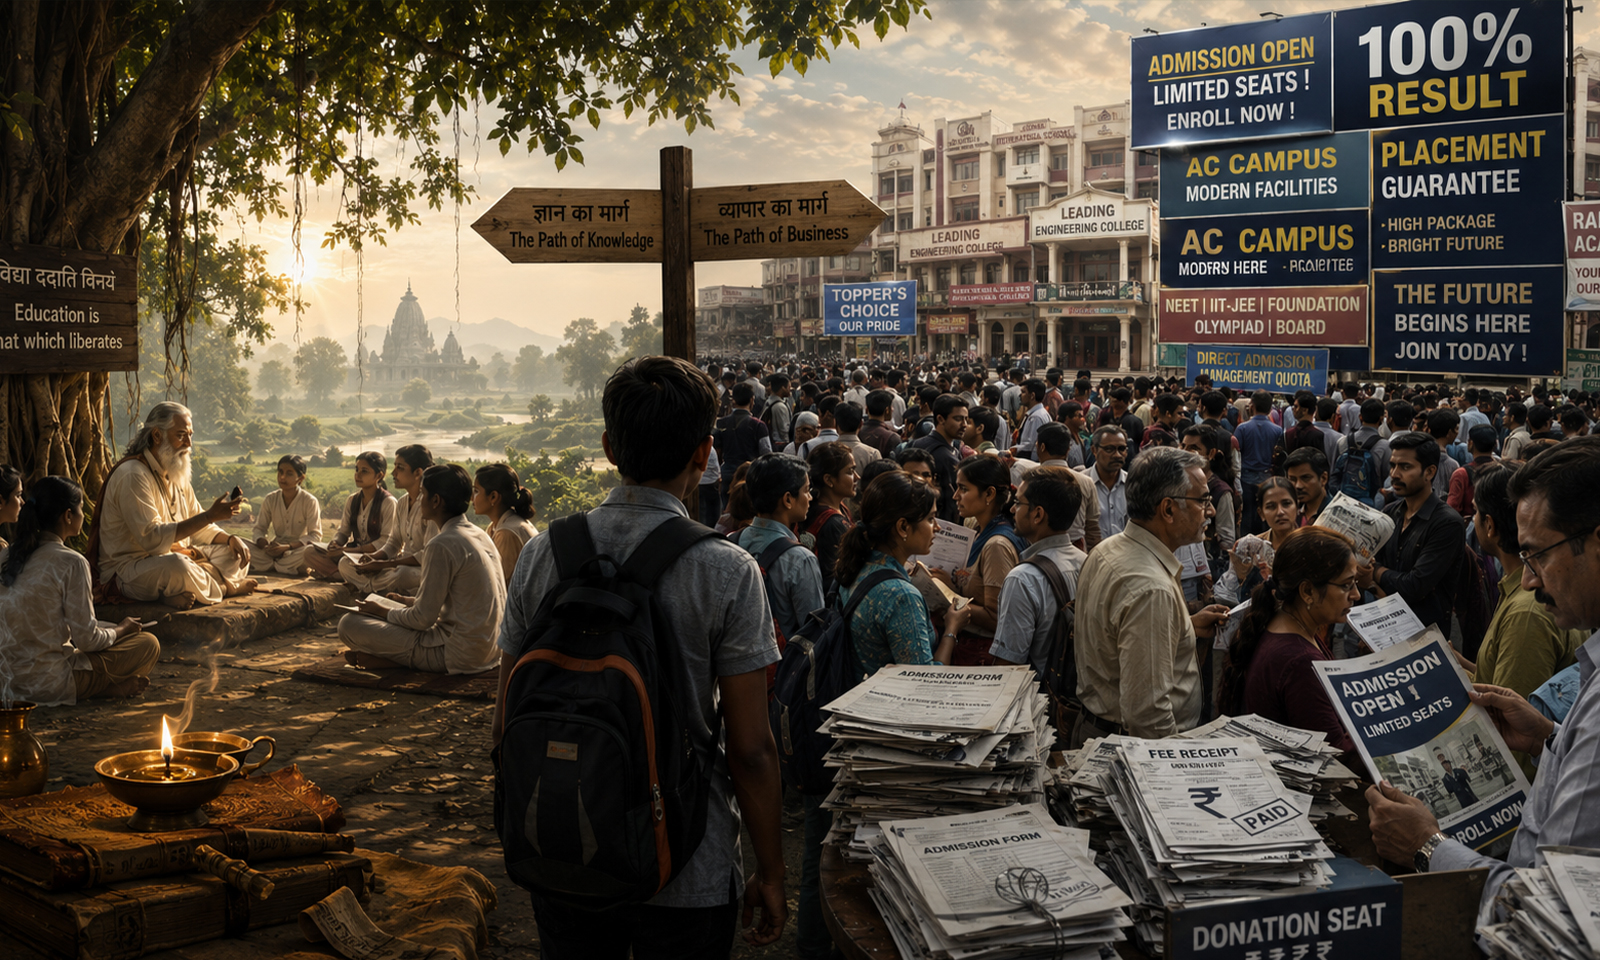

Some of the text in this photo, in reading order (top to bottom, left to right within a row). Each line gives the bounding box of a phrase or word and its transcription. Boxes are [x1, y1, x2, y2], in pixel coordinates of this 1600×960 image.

[1359, 8, 1532, 78] 100%
[1148, 36, 1314, 76] ADMISSION OPEN
[1153, 78, 1229, 106] LIMITED
[1235, 70, 1298, 98] SEATS
[1369, 70, 1527, 118] RESULT
[1167, 108, 1235, 130] ENROLL
[1240, 102, 1284, 124] NOW
[1382, 130, 1546, 168] PLACEMENT
[1186, 147, 1337, 178] AC CAMPUS
[1186, 176, 1338, 202] MODERN FACILITIES
[1381, 169, 1520, 199] GUARANTEE
[532, 199, 630, 224] ज्ञान का मार्ग
[718, 191, 828, 218] व्यापार का मार्ग
[1061, 203, 1115, 220] LEADING
[1035, 220, 1145, 236] ENGINEERING COLLEGE
[1388, 213, 1496, 231] HIGH PACKAGE
[510, 230, 654, 252] The Path of Knowledge
[704, 225, 849, 245] The Path of Business
[932, 229, 980, 244] LEADING
[1180, 224, 1354, 255] AC CAMPUS
[1388, 235, 1504, 253] BRIGHT FUTURE
[1574, 235, 1600, 253] AC
[35, 265, 77, 289] ददाति
[80, 267, 116, 291] विनयं
[1233, 260, 1268, 275] HERE
[832, 286, 908, 302] TOPPER'S
[1393, 282, 1533, 304] THE FUTURE
[15, 303, 100, 324] Education is
[840, 303, 899, 318] CHOICE
[1165, 296, 1360, 313] NEET IIT-JEE FOUNDATION
[839, 319, 901, 332] OUR PRIDE
[1195, 319, 1326, 335] OLYMPIAD BOARD
[1395, 314, 1531, 333] BEGINS HERE
[24, 331, 65, 350] which
[69, 332, 123, 349] liberates
[1197, 351, 1315, 370] DIRECT ADMISSION
[1395, 342, 1440, 360] JOIN
[1446, 343, 1515, 362] TODAY
[1275, 371, 1311, 388] QUOTA
[898, 670, 964, 680] ADMISSION
[1341, 651, 1442, 698] ADMISSION
[1351, 691, 1405, 718] OPEN
[1363, 696, 1453, 739] LIMITED SEATS
[1149, 747, 1239, 759] FEE RECEIPT
[1243, 805, 1289, 830] PAID
[923, 832, 1042, 855] ADMISSION FORM
[1193, 902, 1386, 951] DONATION SEAT
